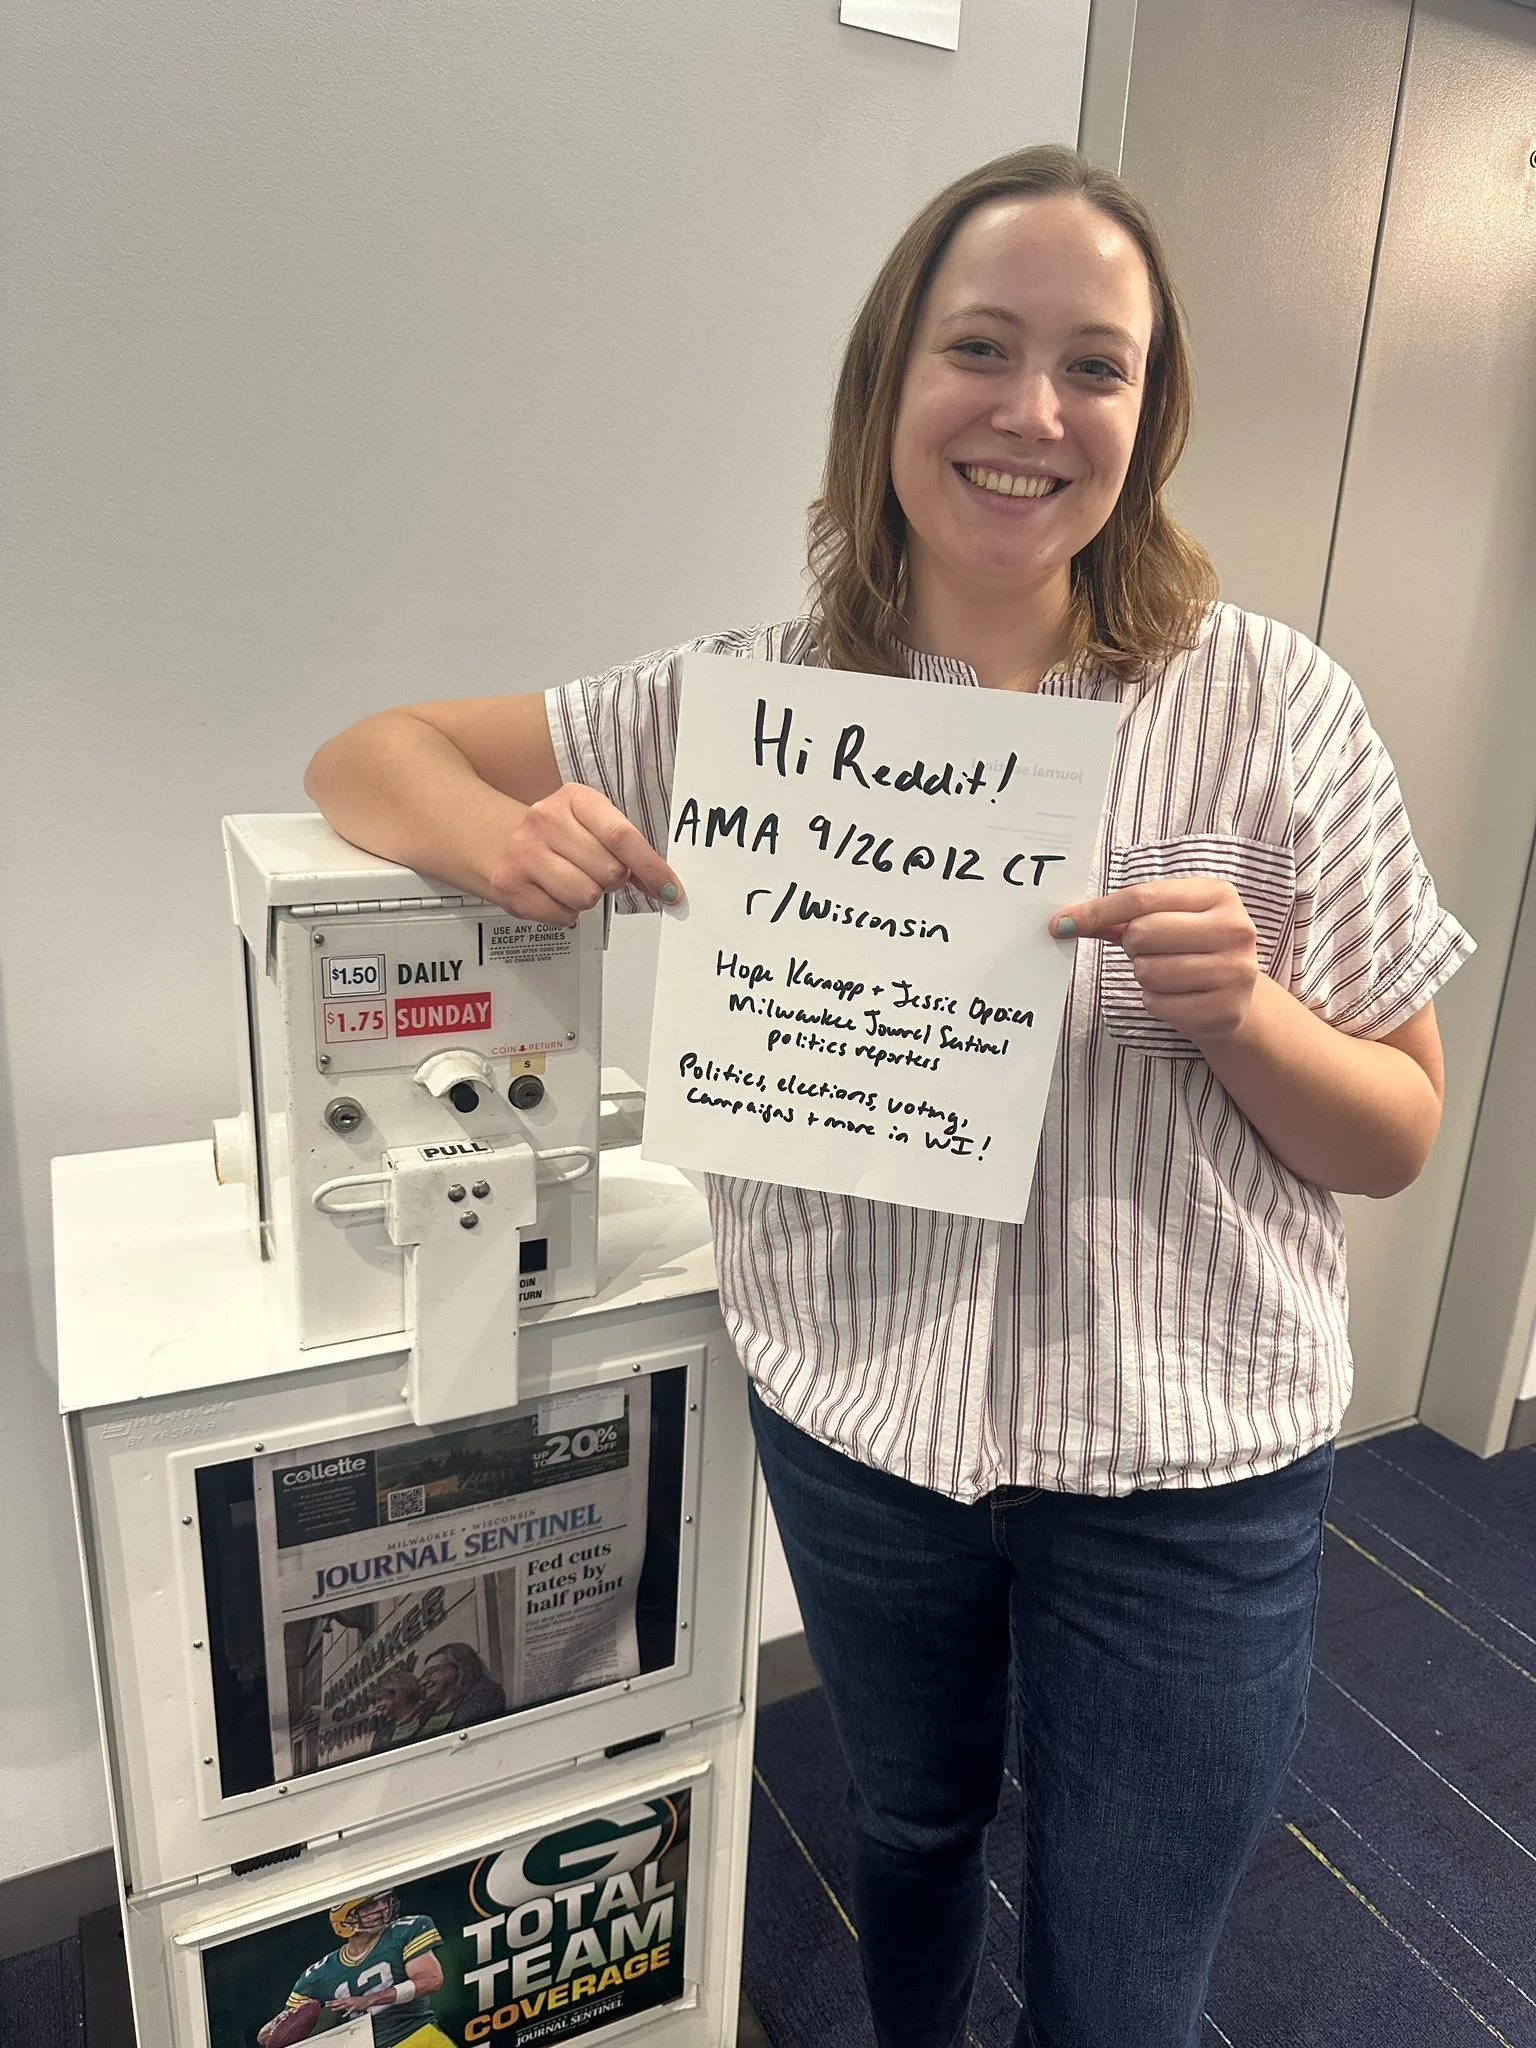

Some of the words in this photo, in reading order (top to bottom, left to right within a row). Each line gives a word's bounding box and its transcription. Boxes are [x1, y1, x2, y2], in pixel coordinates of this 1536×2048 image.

[754, 699, 812, 777] Hi
[833, 725, 1017, 803] Reddit!
[674, 798, 779, 855] AMA
[1003, 854, 1066, 886] CT
[746, 882, 949, 942] r/Wisconsin
[492, 935, 524, 944] EXCEPT
[529, 932, 566, 941] PENNIES
[515, 925, 532, 933] ANY
[332, 965, 378, 985] $1.50
[398, 960, 463, 985] DAILY
[716, 950, 774, 989] Hope
[892, 980, 957, 1015] Jessie
[327, 1010, 384, 1033] $1.75
[397, 1001, 491, 1030] SUNDAY
[730, 994, 856, 1031] Milwaukee
[491, 1046, 517, 1055] COIN
[529, 1041, 563, 1051] RETURN
[768, 1030, 847, 1056] politics
[855, 1044, 940, 1071] reporters
[423, 1143, 489, 1158] PULL
[824, 1118, 875, 1136] more
[889, 1125, 908, 1143] in
[925, 1132, 991, 1161] WI!
[519, 1278, 536, 1288] OIN
[519, 1290, 543, 1301] TURN
[533, 1451, 549, 1460] UP
[534, 1459, 548, 1468] TO
[595, 1442, 617, 1452] OFF
[283, 1457, 367, 1485] collette
[387, 1528, 457, 1550] MILWAUKEE
[472, 1509, 536, 1530] WISCONSIN
[312, 1540, 457, 1600] JOURNAL
[465, 1503, 602, 1558] SENTINEL
[527, 1552, 563, 1576] Fed
[569, 1543, 612, 1564] cuts
[527, 1572, 578, 1596] rates
[583, 1563, 607, 1581] by
[527, 1589, 570, 1615] half
[573, 1575, 623, 1606] point
[463, 1858, 675, 1963] TOTAL
[464, 1896, 673, 2010] TEAM
[465, 1942, 670, 2042] COVERAGE
[515, 2020, 569, 2048] JOURNAL
[570, 2000, 624, 2025] SENTINEL
